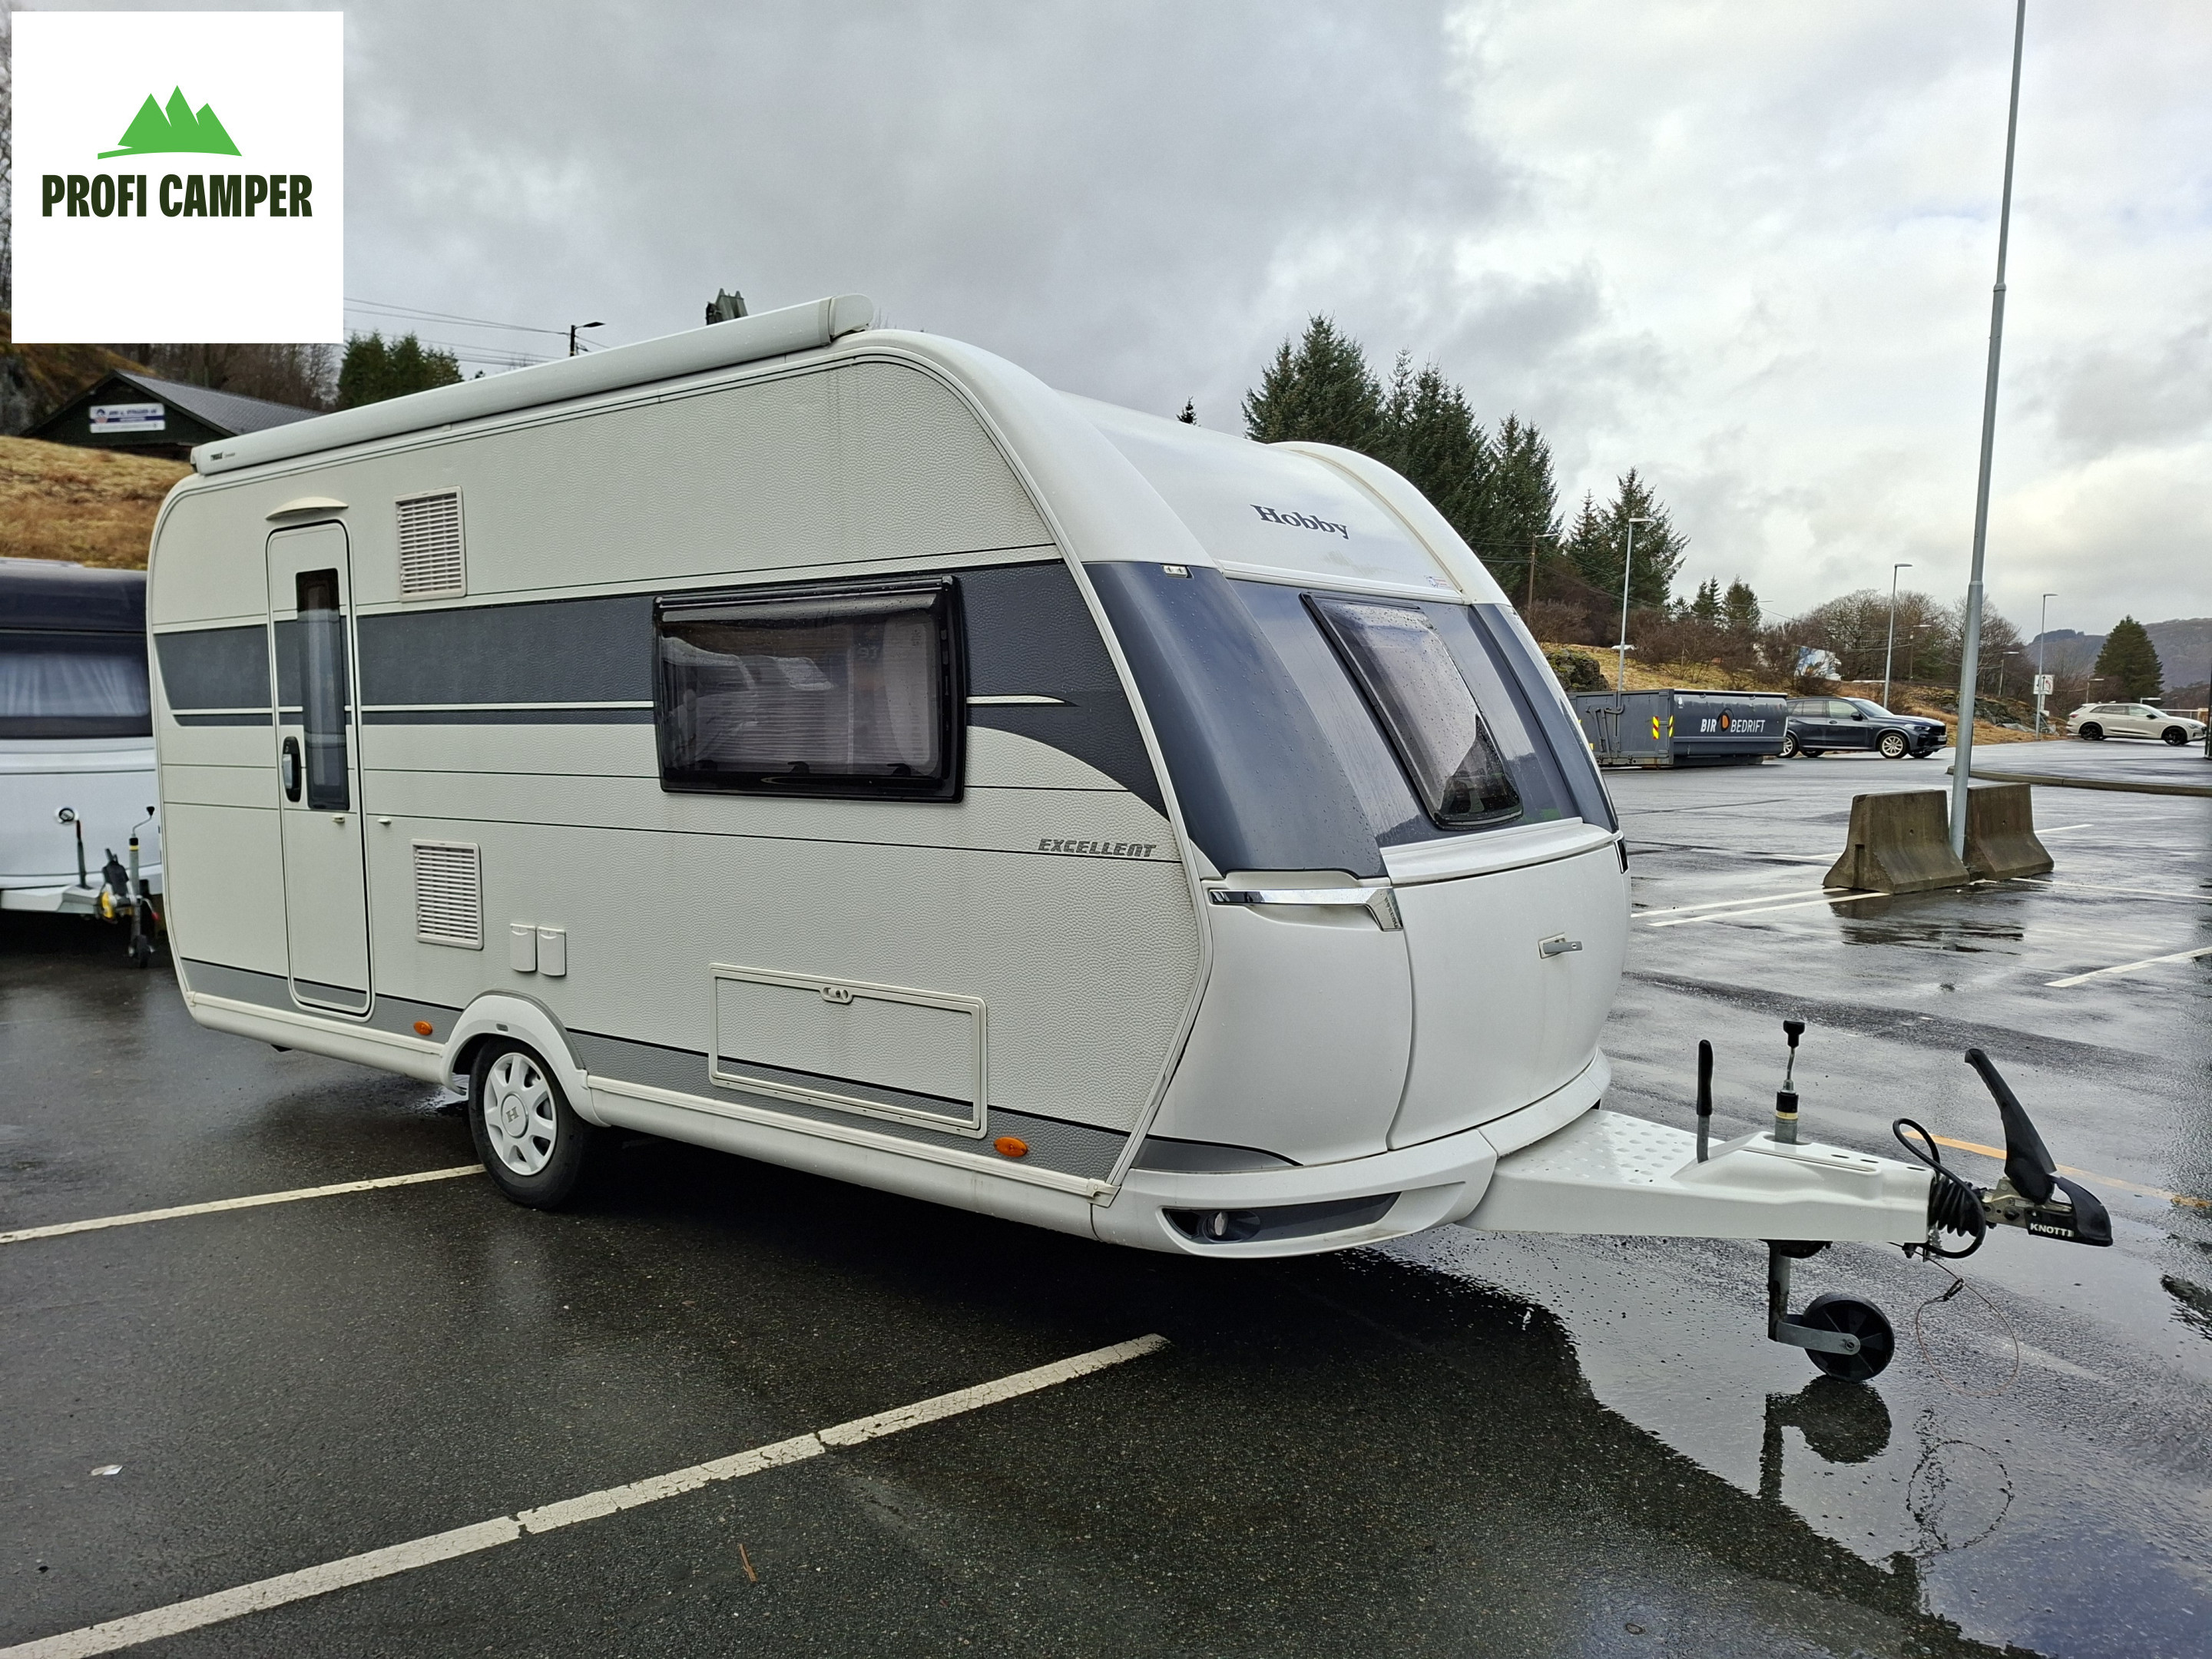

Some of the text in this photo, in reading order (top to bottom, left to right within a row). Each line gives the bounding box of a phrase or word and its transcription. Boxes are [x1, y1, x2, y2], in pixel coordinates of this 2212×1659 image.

[1250, 504, 1349, 539] Hobby
[1700, 718, 1766, 733] BIR BEDRIFT
[1038, 838, 1157, 858] EXCELLENT
[2030, 1222, 2068, 1237] KNOTT
